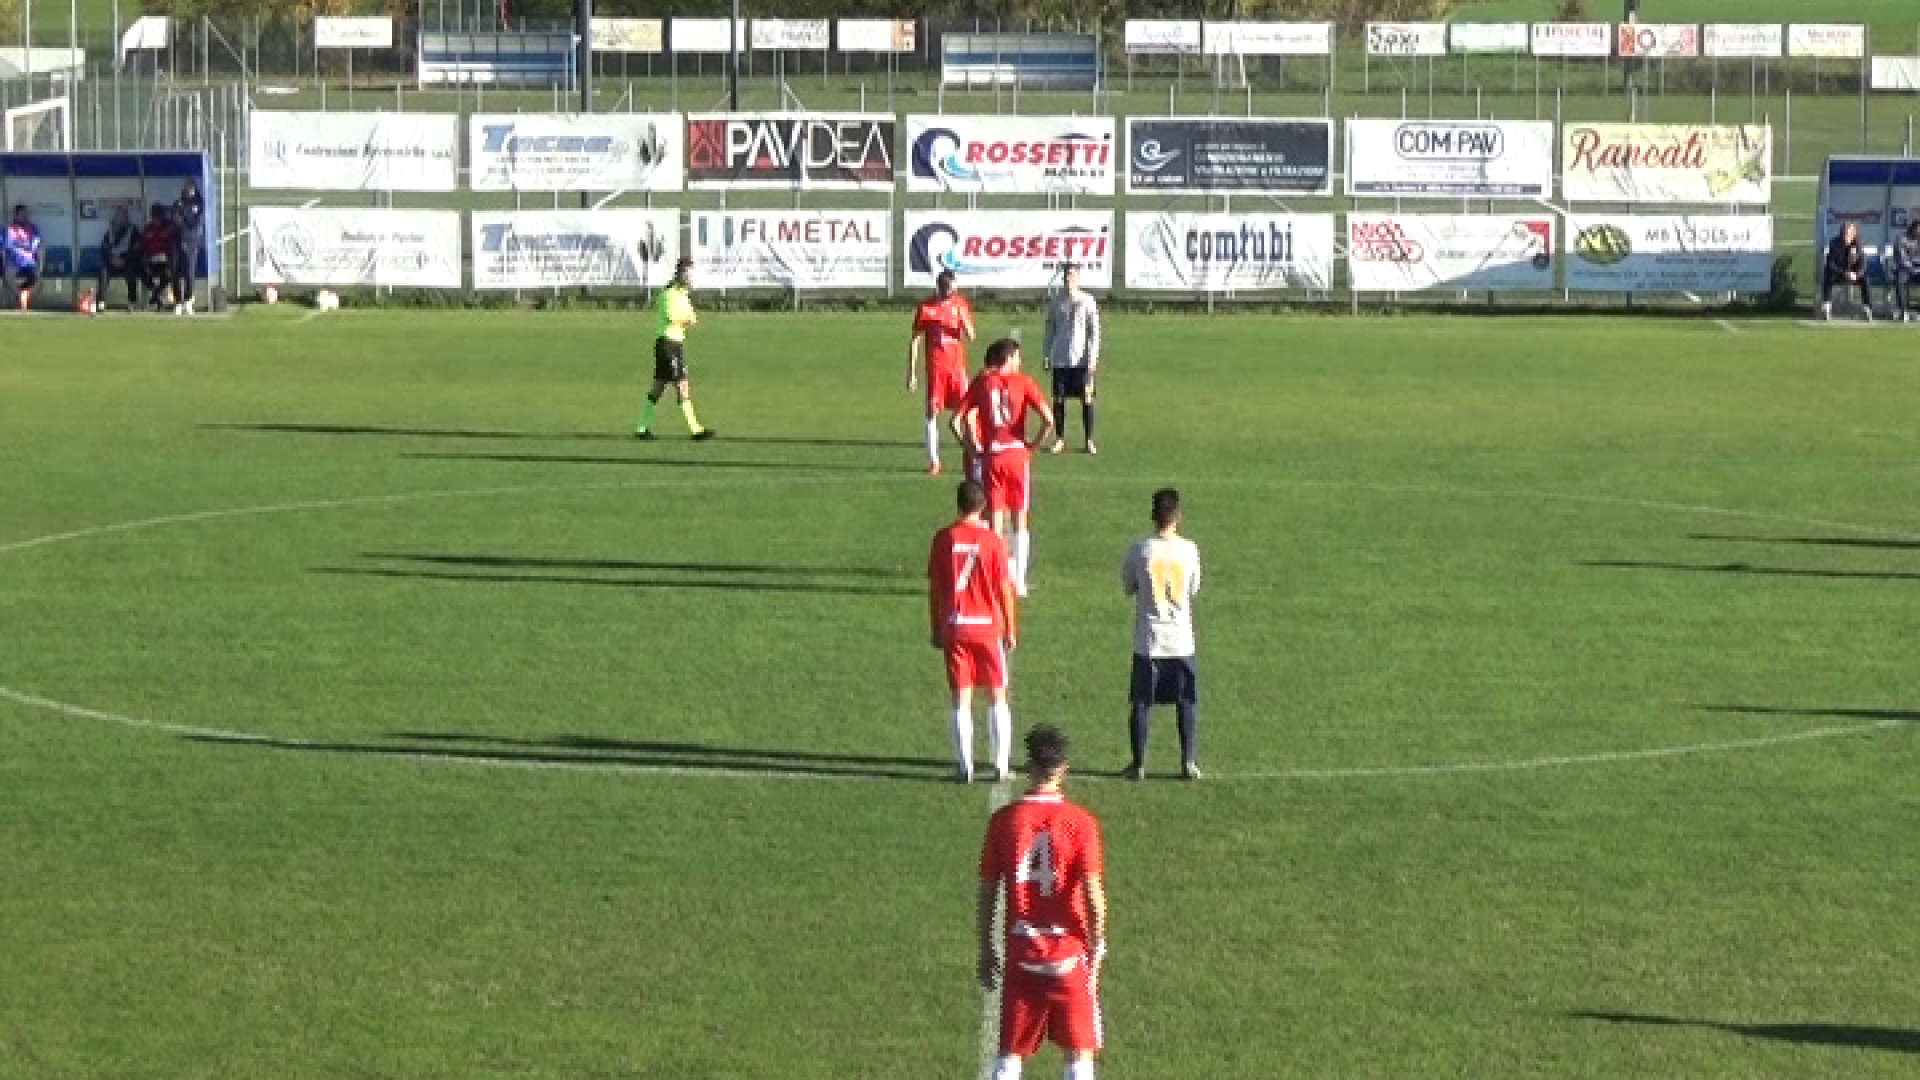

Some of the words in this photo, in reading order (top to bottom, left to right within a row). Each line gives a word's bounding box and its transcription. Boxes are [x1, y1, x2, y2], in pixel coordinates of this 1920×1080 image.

[964, 141, 1111, 165] ROSSETTI
[1570, 128, 1708, 172] Rancati
[962, 236, 1108, 259] ROSSETTI
[1185, 220, 1295, 263] comtubi
[952, 543, 980, 592] 7
[1014, 831, 1058, 897] 4
